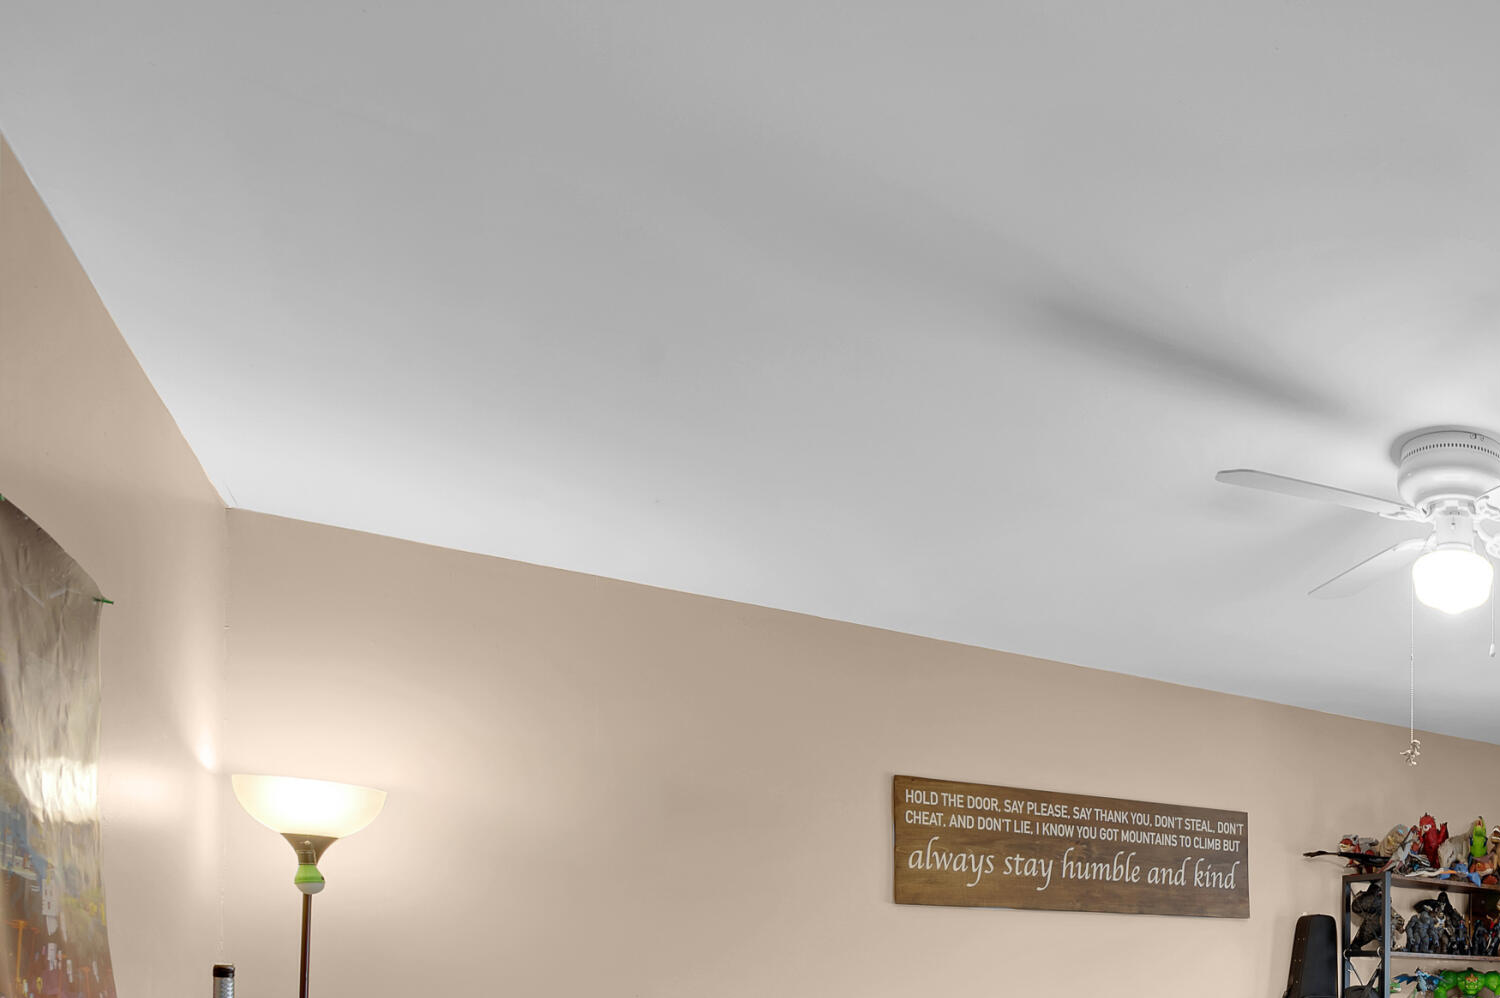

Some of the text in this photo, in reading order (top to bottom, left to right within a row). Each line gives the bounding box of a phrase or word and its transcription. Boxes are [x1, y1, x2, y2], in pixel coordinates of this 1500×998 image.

[906, 789, 938, 805] HOLD
[941, 792, 964, 808] THE
[1004, 799, 1024, 814] SAY
[1073, 806, 1092, 820] SAY
[1094, 808, 1128, 824] THANK
[1155, 815, 1183, 829] DON'T
[1217, 821, 1244, 835] DON'T
[949, 814, 974, 829] AND
[978, 816, 1011, 832] DON'T
[1036, 822, 1039, 834] I
[1042, 823, 1074, 838] KNOW
[1076, 825, 1097, 839] YOU
[1100, 828, 1119, 841] GOT
[1121, 830, 1177, 847] MOUNTAINS
[1179, 835, 1191, 848] TO
[1193, 837, 1221, 851] CLIMB
[1223, 840, 1240, 852] BUT
[908, 836, 1240, 891] always stay humble and kind
